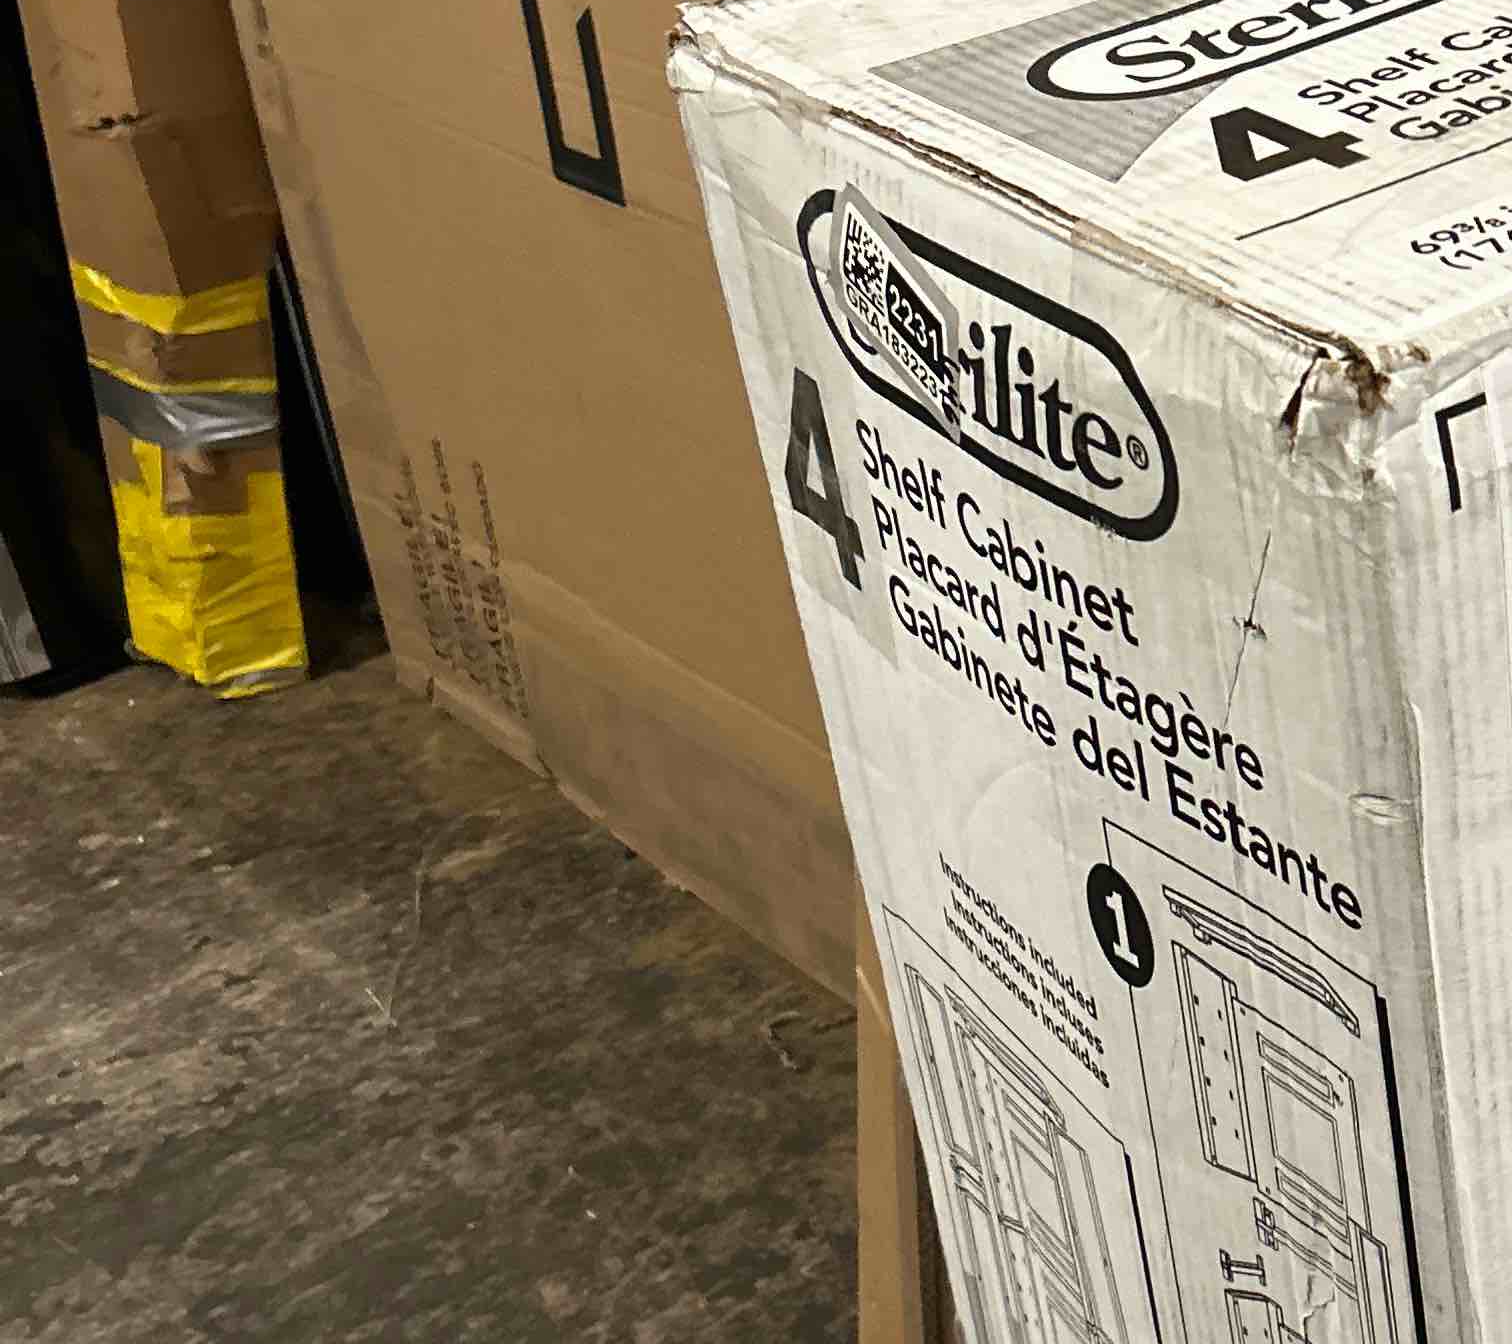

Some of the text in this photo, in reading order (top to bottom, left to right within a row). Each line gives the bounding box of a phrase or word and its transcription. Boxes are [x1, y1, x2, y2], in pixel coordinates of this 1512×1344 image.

[1210, 106, 1373, 183] 4
[1297, 47, 1440, 107] Shelf
[889, 284, 944, 363] 2231
[784, 366, 867, 592] 4
[855, 419, 1141, 647] Shelf Cabinet
[871, 496, 1265, 792] Placard d'Étagère
[887, 573, 1364, 931] Gabinete del Estante
[938, 847, 1099, 1021] Instructions included
[943, 906, 1110, 1089] Instrucciones incluidas
[950, 888, 1104, 1055] Instructions incluses
[1104, 891, 1140, 969] 1
